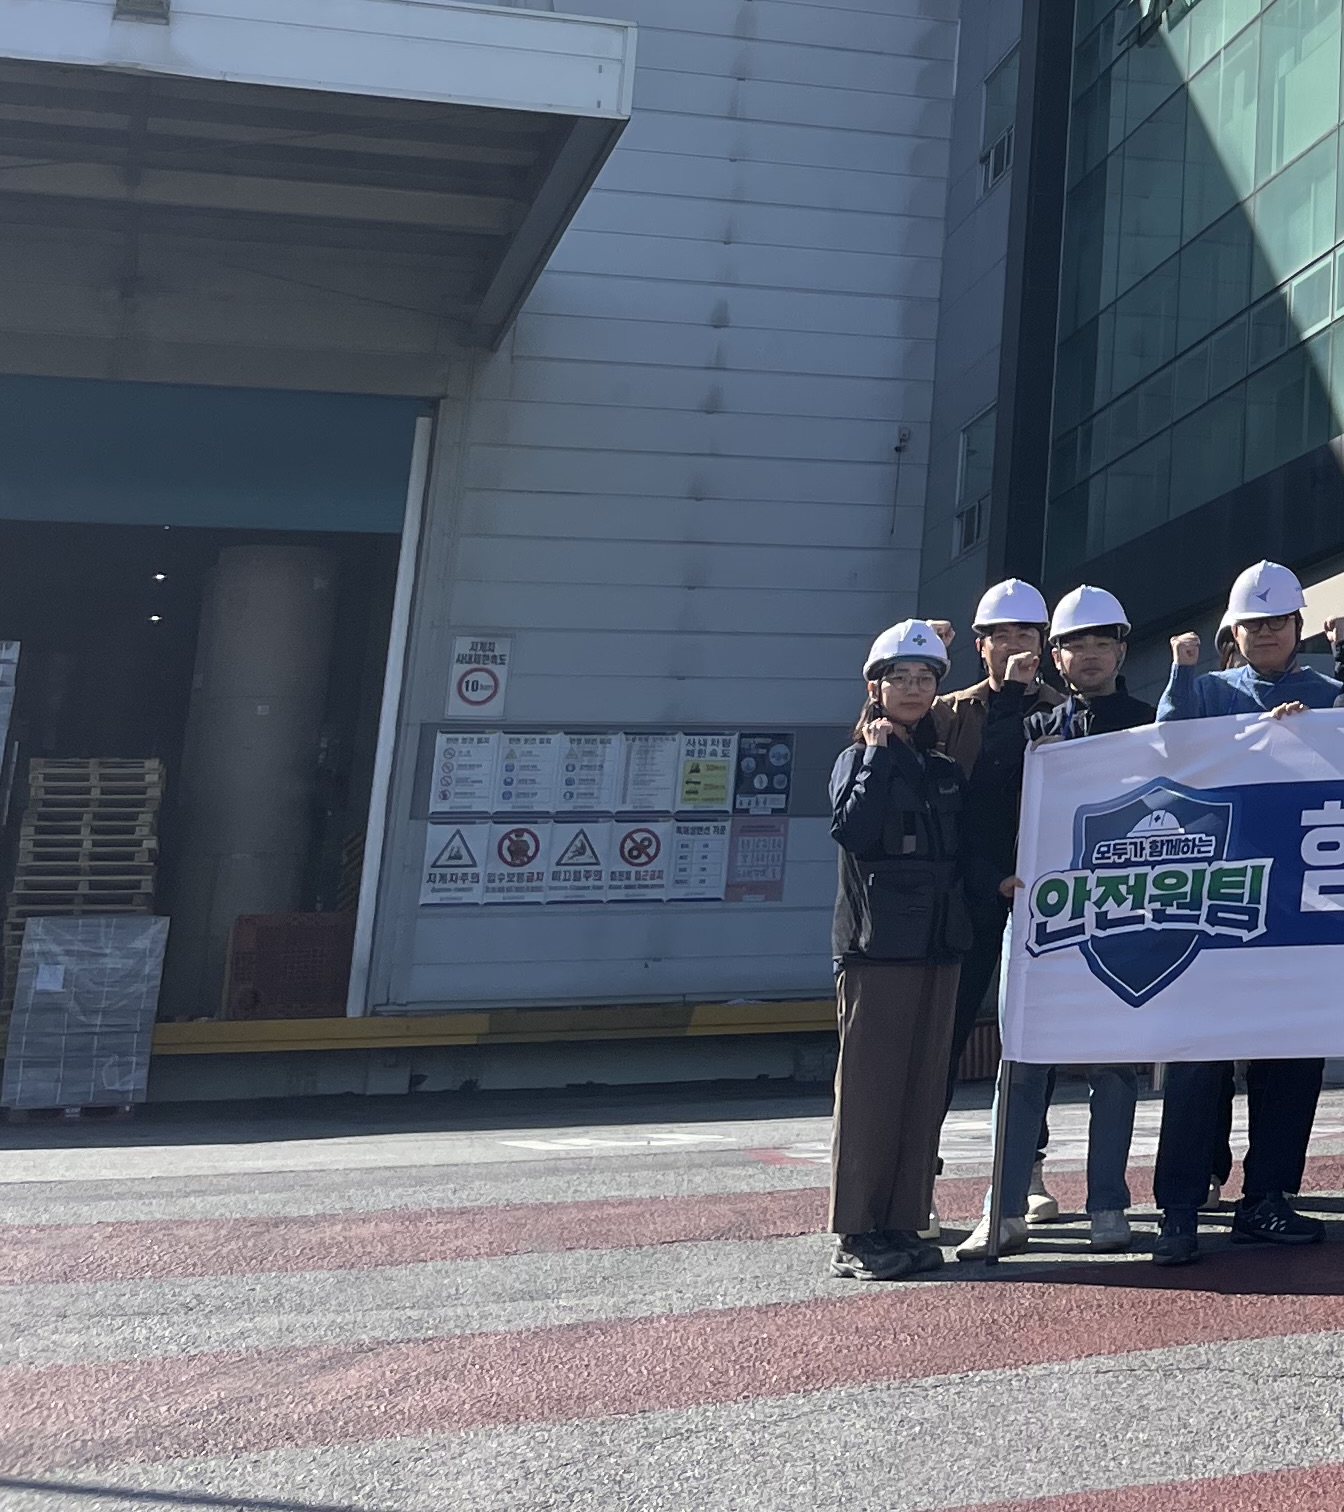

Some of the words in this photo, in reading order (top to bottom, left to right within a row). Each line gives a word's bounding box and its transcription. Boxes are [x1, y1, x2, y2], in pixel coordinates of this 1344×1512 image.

[464, 679, 479, 692] 10
[1095, 839, 1147, 863] 모두가
[1148, 835, 1215, 858] 함께하는
[1036, 865, 1267, 945] 안전원팀
